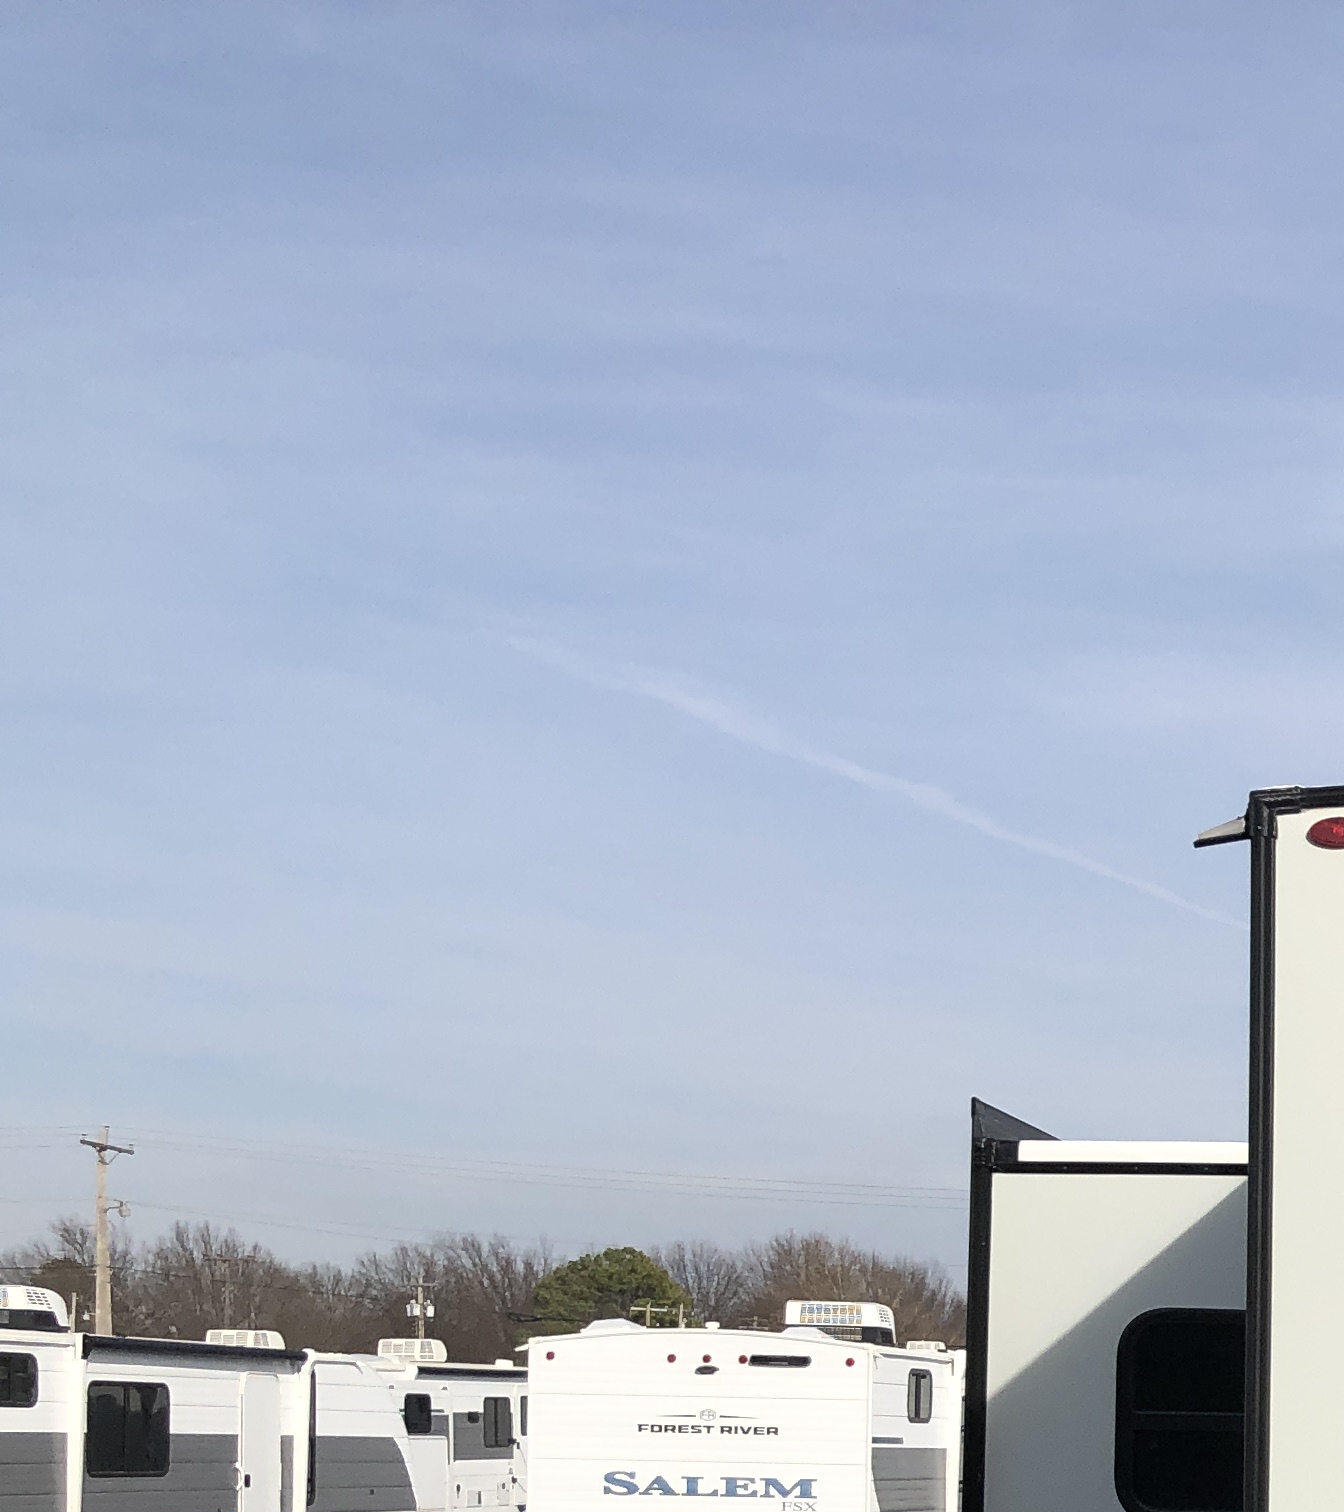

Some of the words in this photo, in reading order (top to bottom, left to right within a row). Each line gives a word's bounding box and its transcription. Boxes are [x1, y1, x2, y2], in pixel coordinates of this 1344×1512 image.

[637, 1423, 715, 1434] FOREST
[719, 1425, 779, 1436] RIVER
[603, 1470, 818, 1499] SALEM
[781, 1501, 818, 1512] FSX
